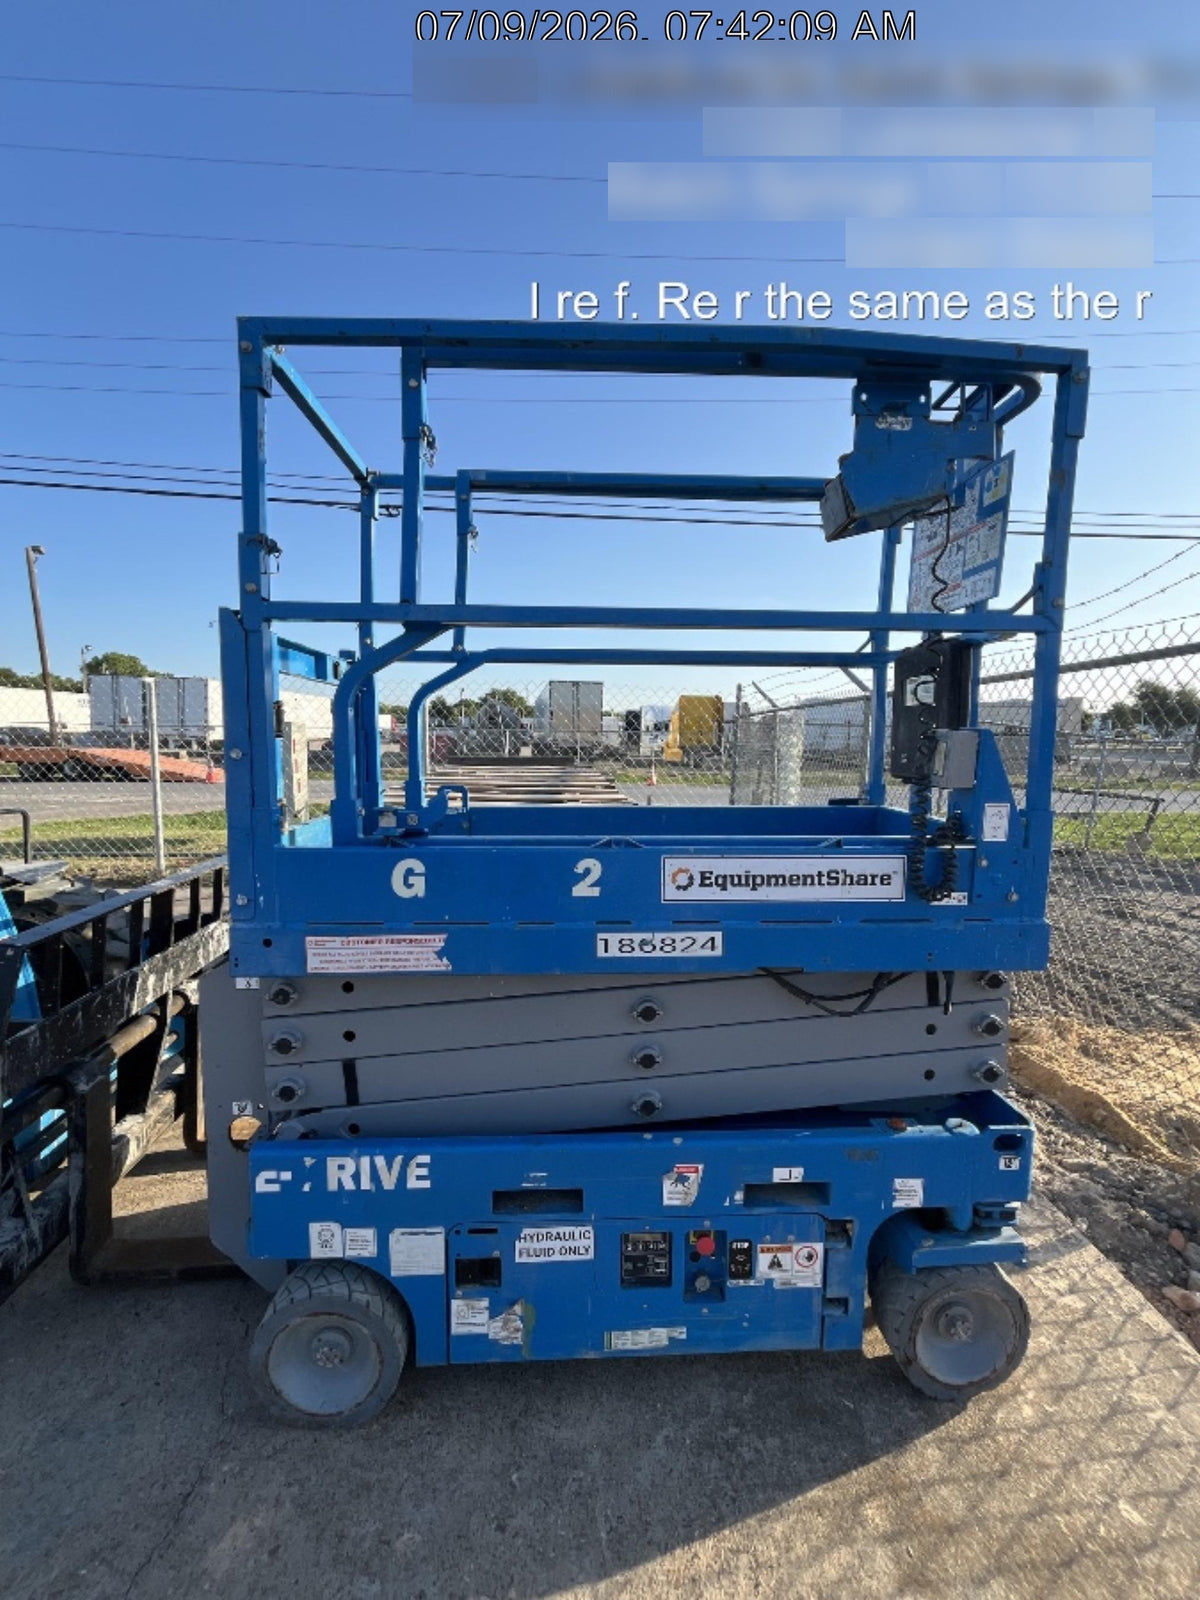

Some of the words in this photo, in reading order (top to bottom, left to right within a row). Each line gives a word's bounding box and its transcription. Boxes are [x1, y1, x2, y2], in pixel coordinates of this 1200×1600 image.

[391, 858, 426, 898] G
[572, 858, 602, 897] 2
[698, 869, 893, 891] EquipmentShare
[599, 936, 718, 954] 186824
[518, 1229, 592, 1243] HYDRAULIC
[518, 1247, 556, 1258] FLUID
[558, 1245, 592, 1256] ONLY
